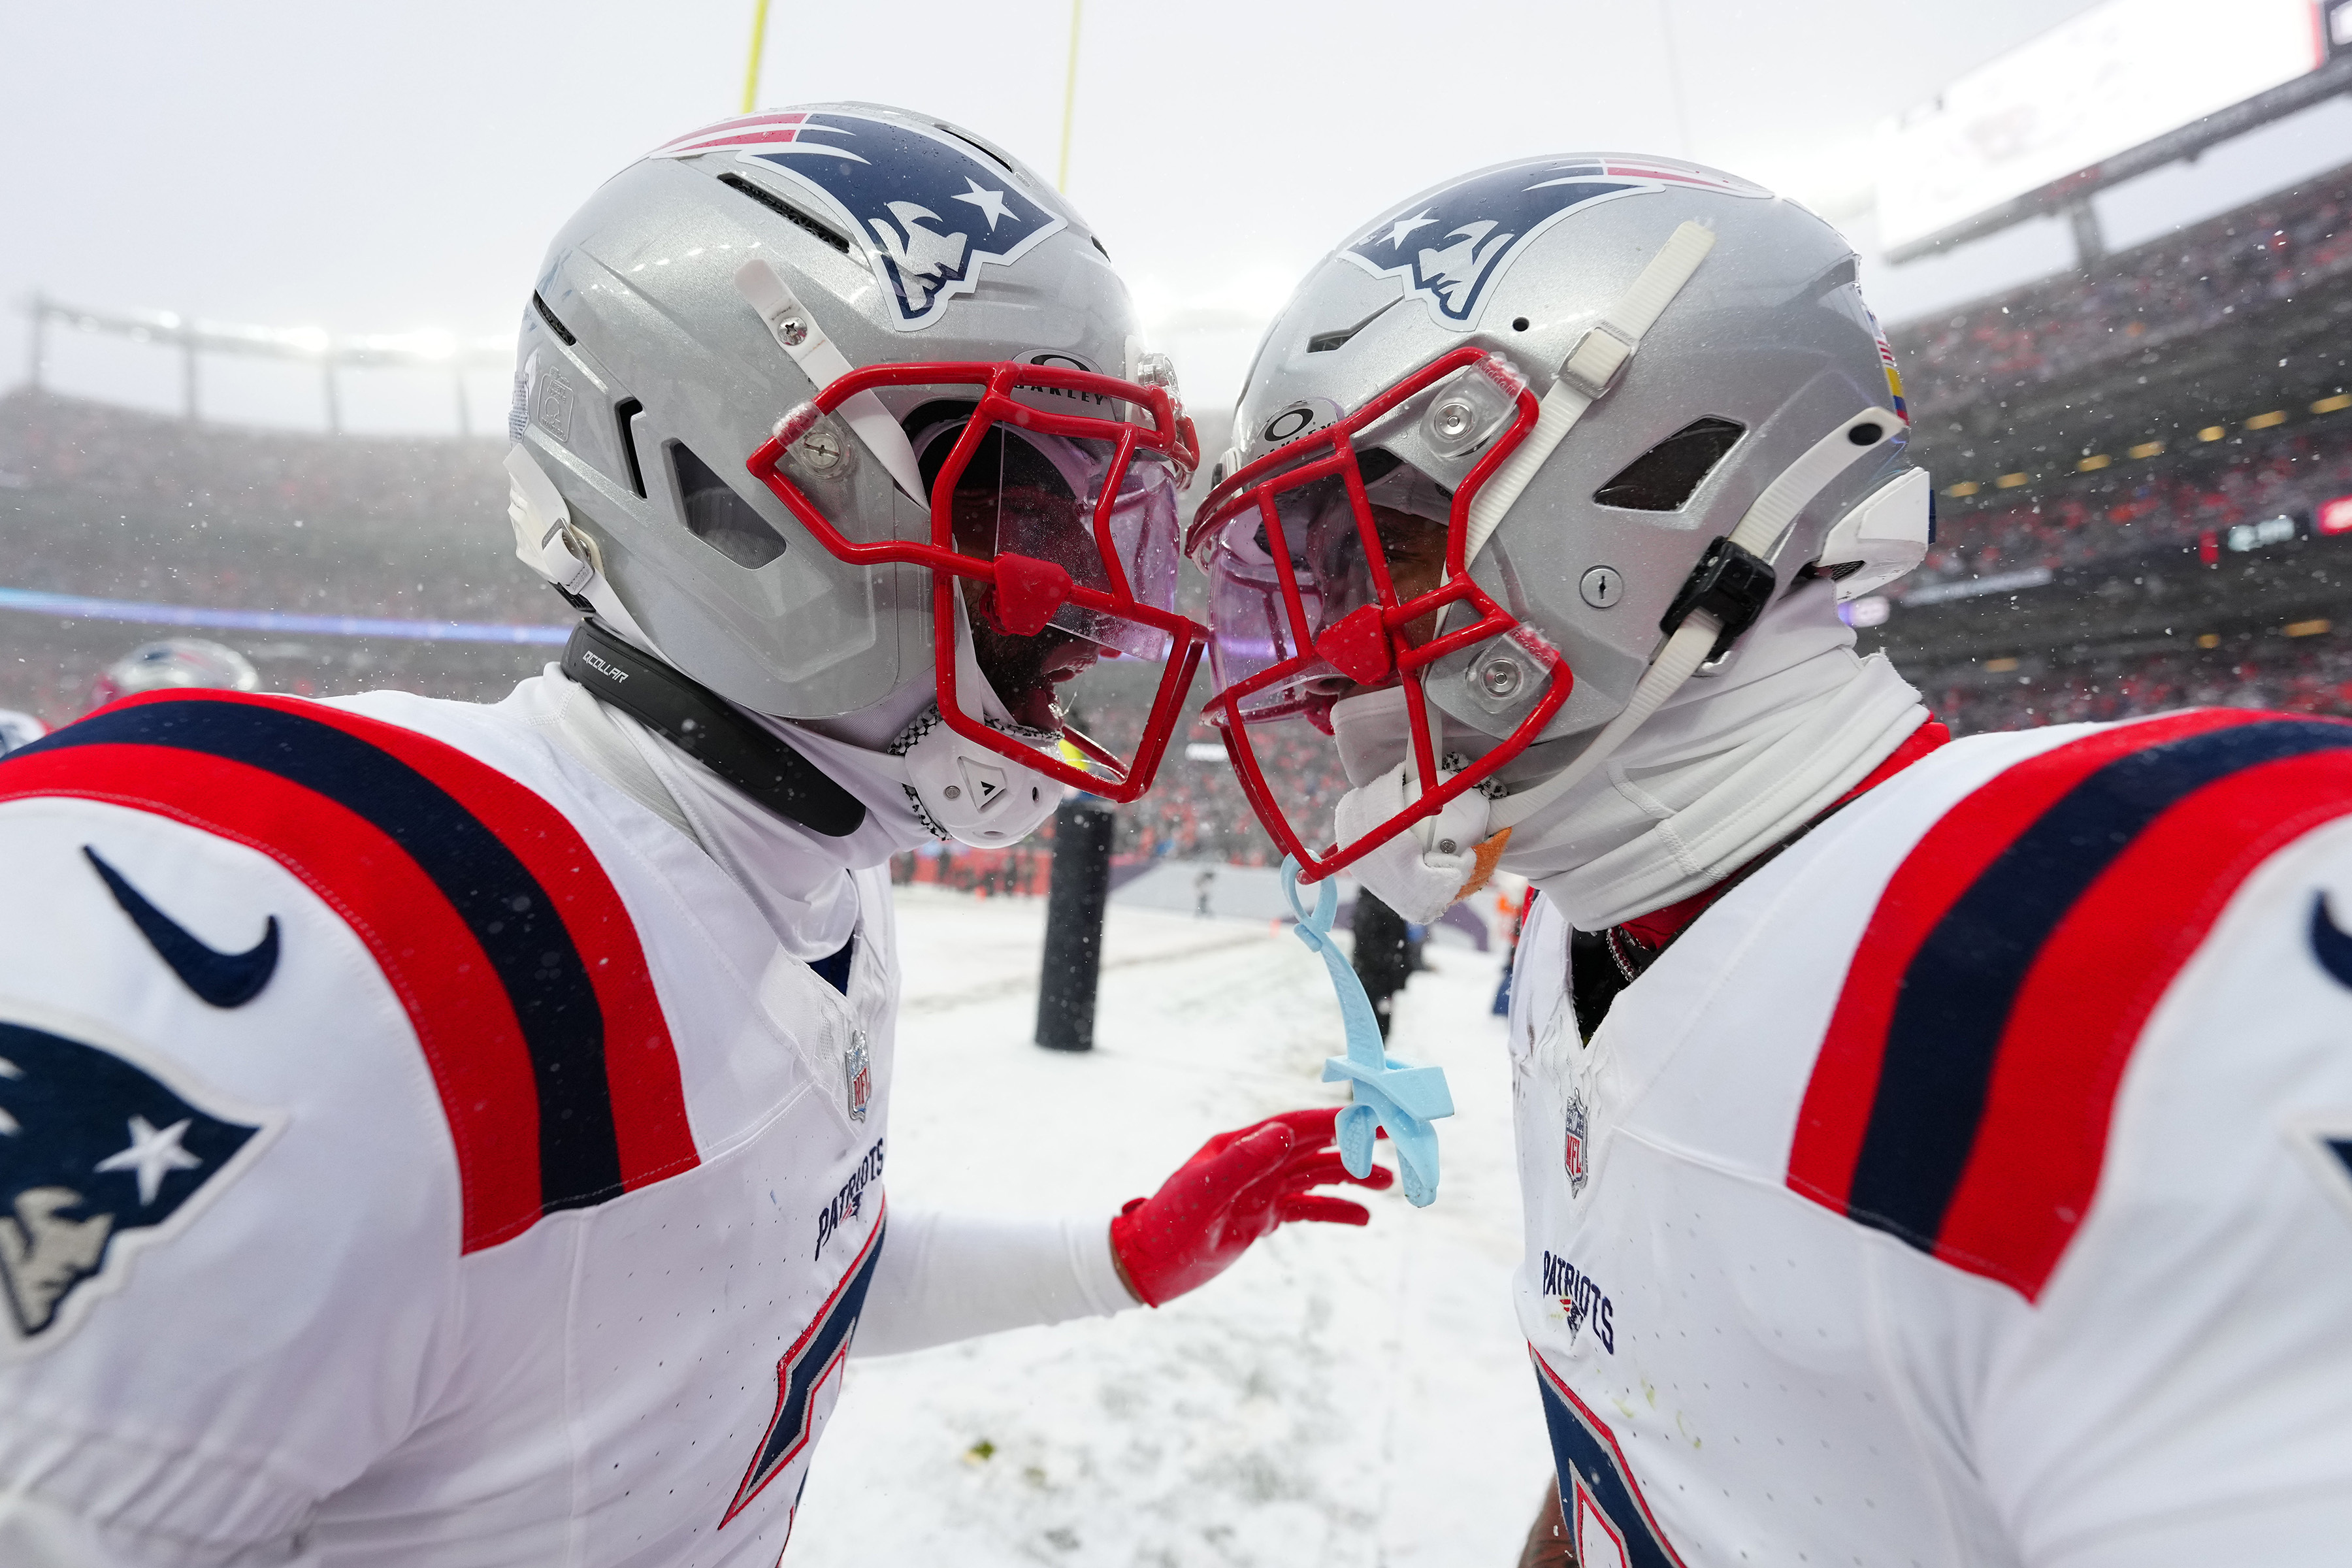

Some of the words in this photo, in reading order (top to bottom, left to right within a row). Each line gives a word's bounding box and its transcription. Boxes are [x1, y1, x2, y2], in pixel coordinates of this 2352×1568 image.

[1013, 385, 1102, 406] AKLEY
[582, 650, 629, 683] QCOLLAR
[853, 1067, 870, 1107] NFL
[1565, 1134, 1582, 1176] NFL
[815, 1137, 883, 1261] PATRIOTS
[1543, 1250, 1614, 1355] PATRIOTS
